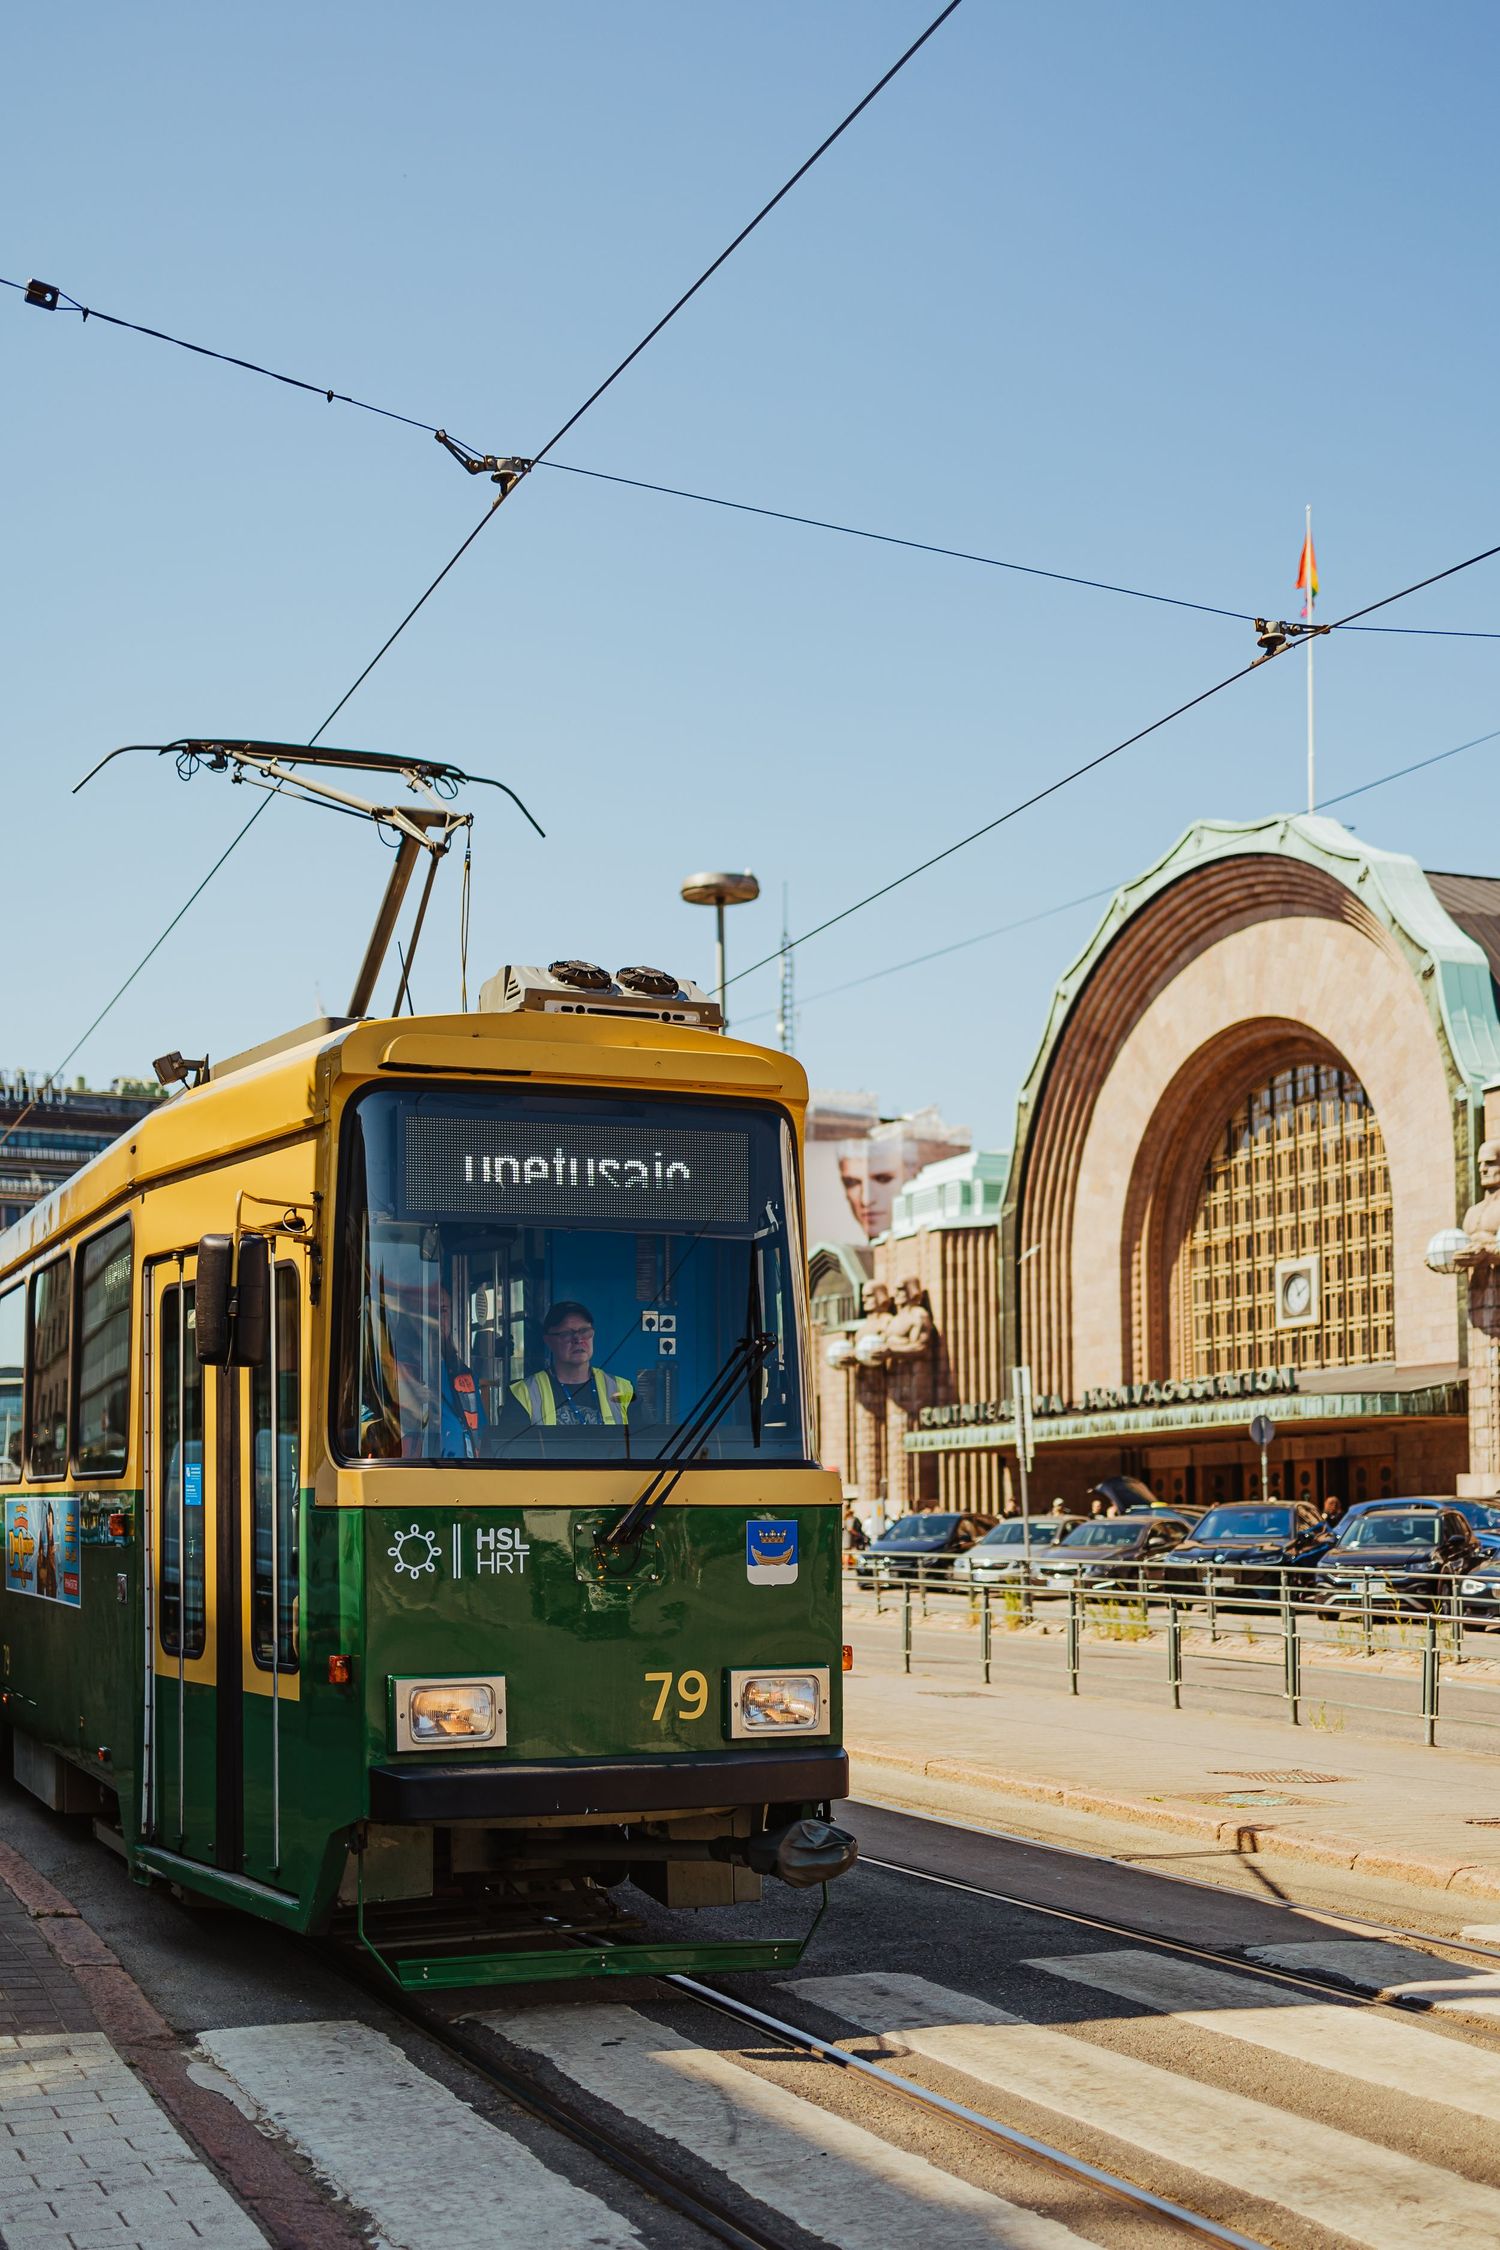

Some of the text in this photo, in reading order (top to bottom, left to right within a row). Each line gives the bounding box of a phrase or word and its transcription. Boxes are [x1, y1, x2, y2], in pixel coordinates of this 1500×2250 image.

[919, 1394, 1064, 1427] RAUTATIEAMA
[476, 1527, 530, 1550] HSL
[476, 1552, 530, 1575] HRT
[645, 1670, 708, 1721] 79
